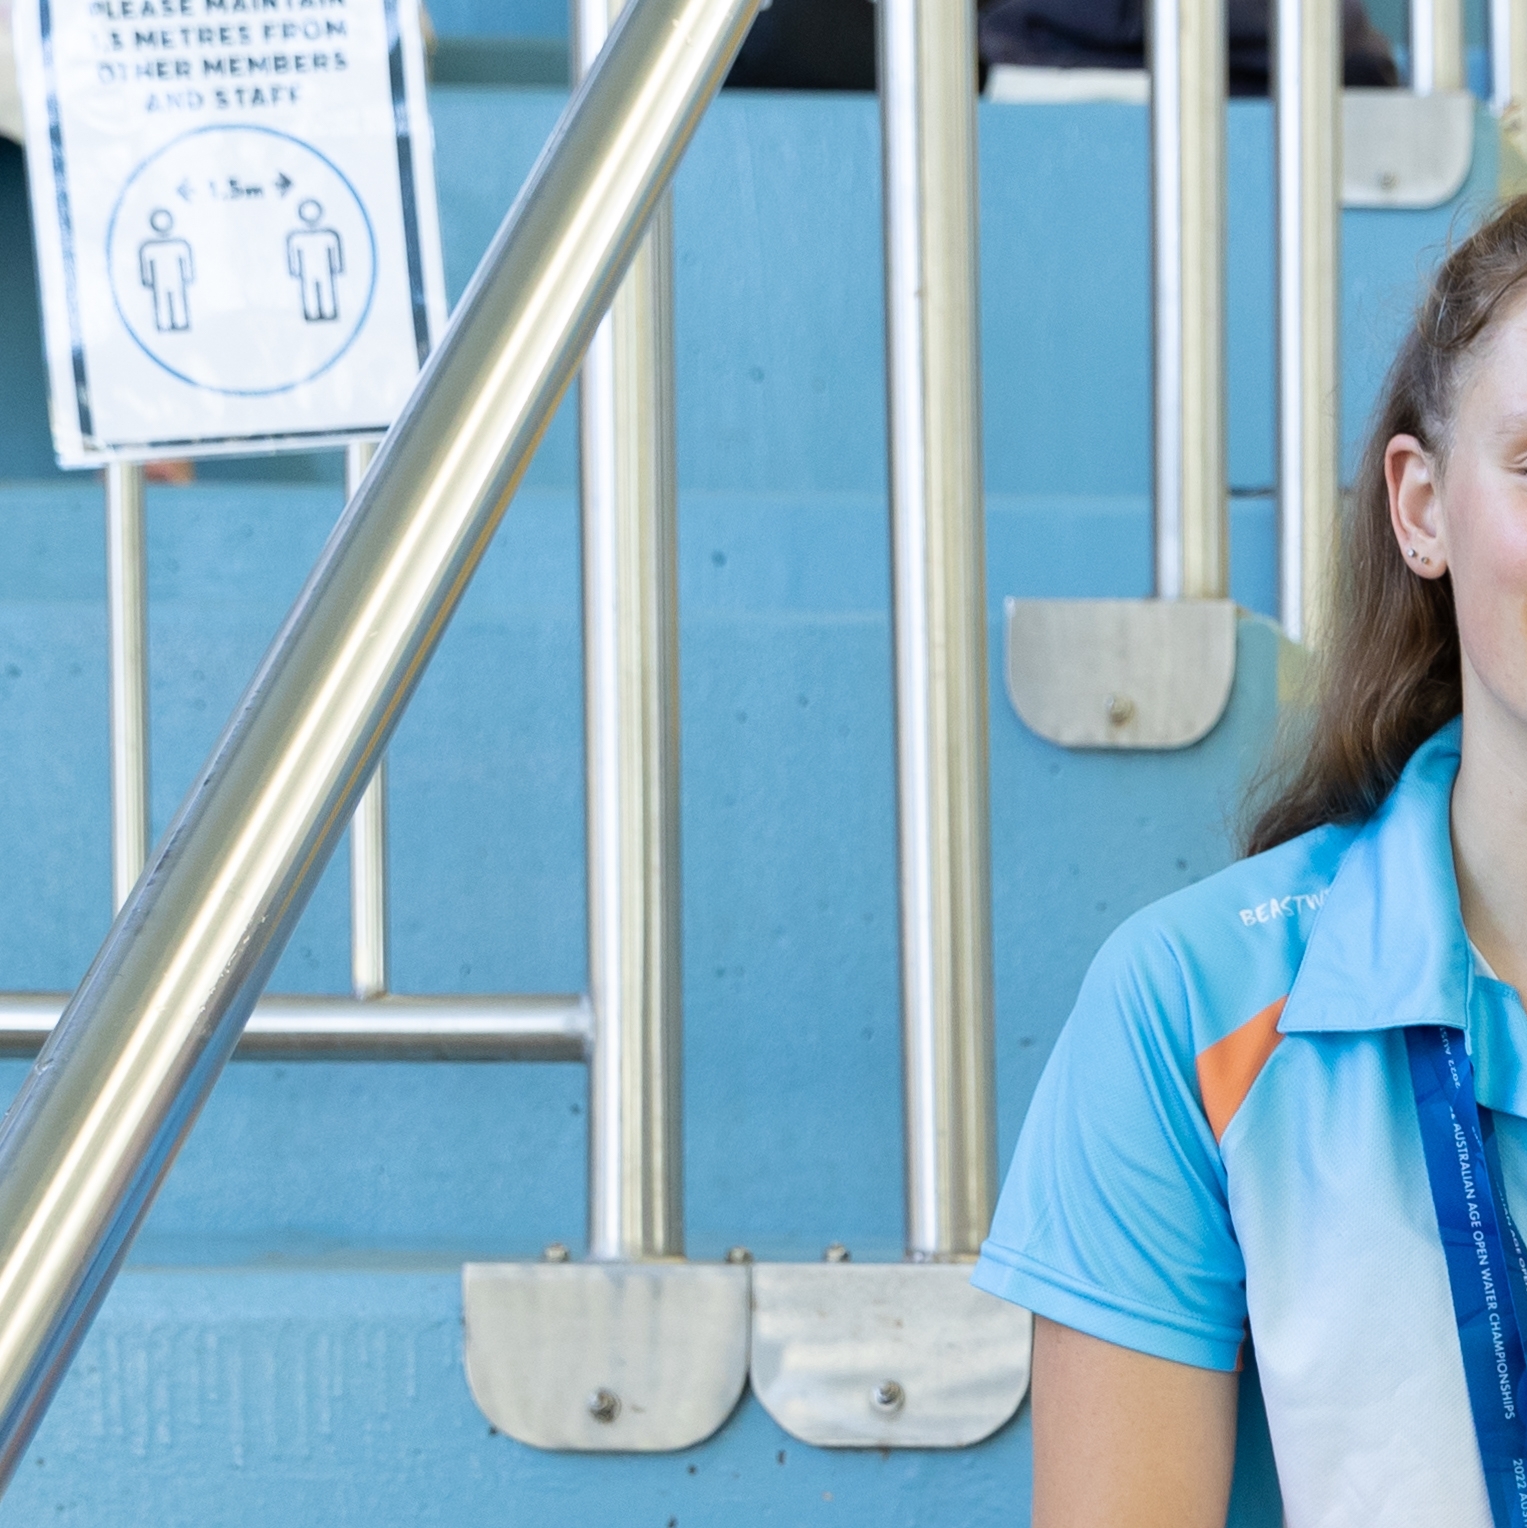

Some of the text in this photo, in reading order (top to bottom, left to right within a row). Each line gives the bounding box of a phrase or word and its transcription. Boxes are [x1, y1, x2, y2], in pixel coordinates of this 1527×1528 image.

[135, 25, 251, 50] METRES
[263, 19, 346, 42] FROM
[98, 51, 347, 84] OTHER MEMBERS
[145, 85, 300, 113] AND STAFF
[1453, 1122, 1516, 1420] AUSTRALIAN AGE OPEN WATER CHAMPIONSHIPS
[1512, 1458, 1527, 1489] 2022
